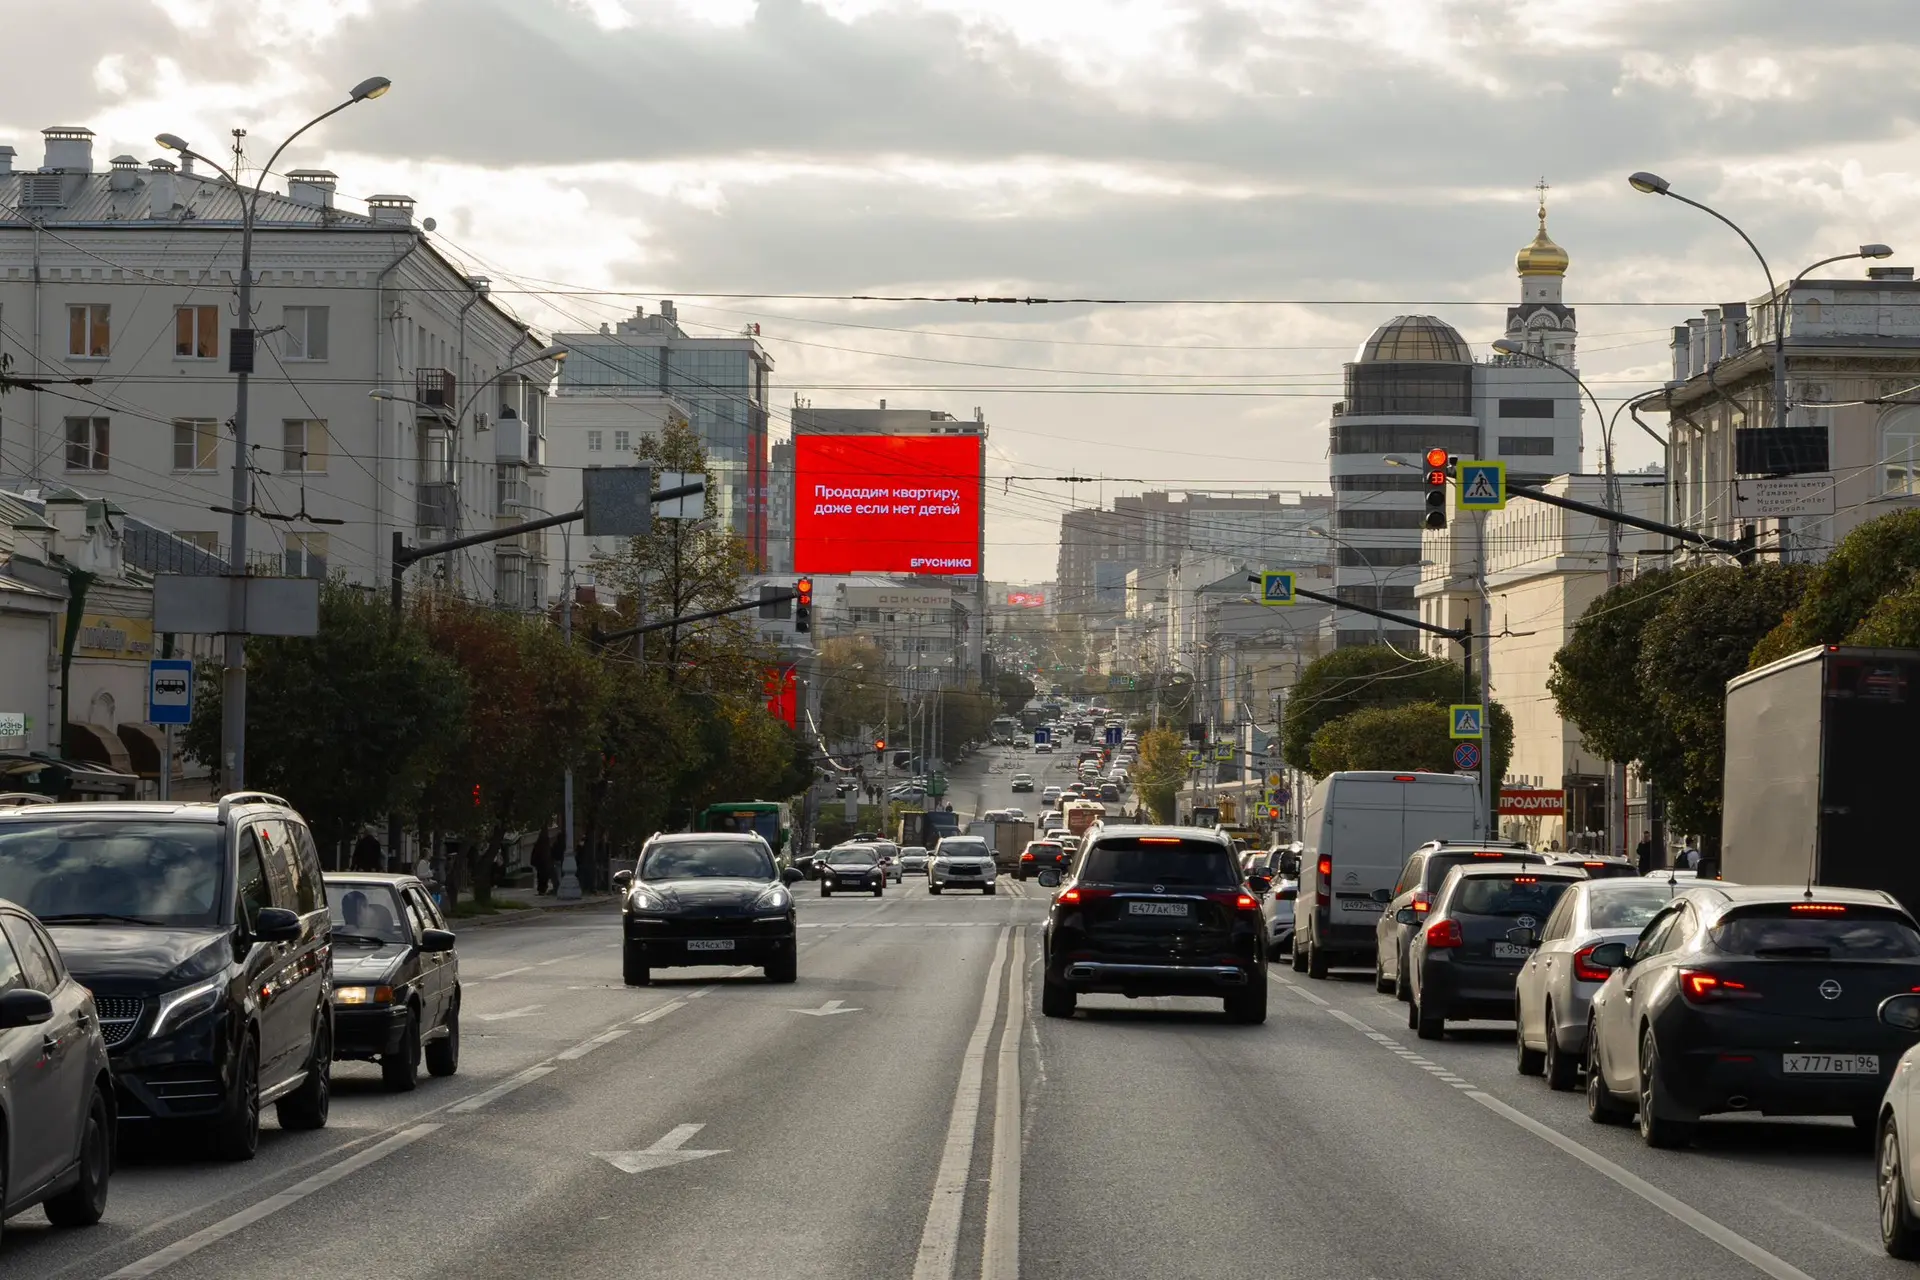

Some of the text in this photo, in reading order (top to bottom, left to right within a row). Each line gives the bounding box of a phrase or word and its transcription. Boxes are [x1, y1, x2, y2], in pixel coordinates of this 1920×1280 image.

[1431, 472, 1444, 484] 33
[1756, 481, 1826, 490] Музейный центр
[814, 485, 961, 501] Продадим квартиру,
[813, 503, 961, 516] даже если нет детей
[878, 595, 909, 603] ДОМ
[0, 721, 23, 729] изнь
[1499, 796, 1563, 809] ПРОДУКТЫ
